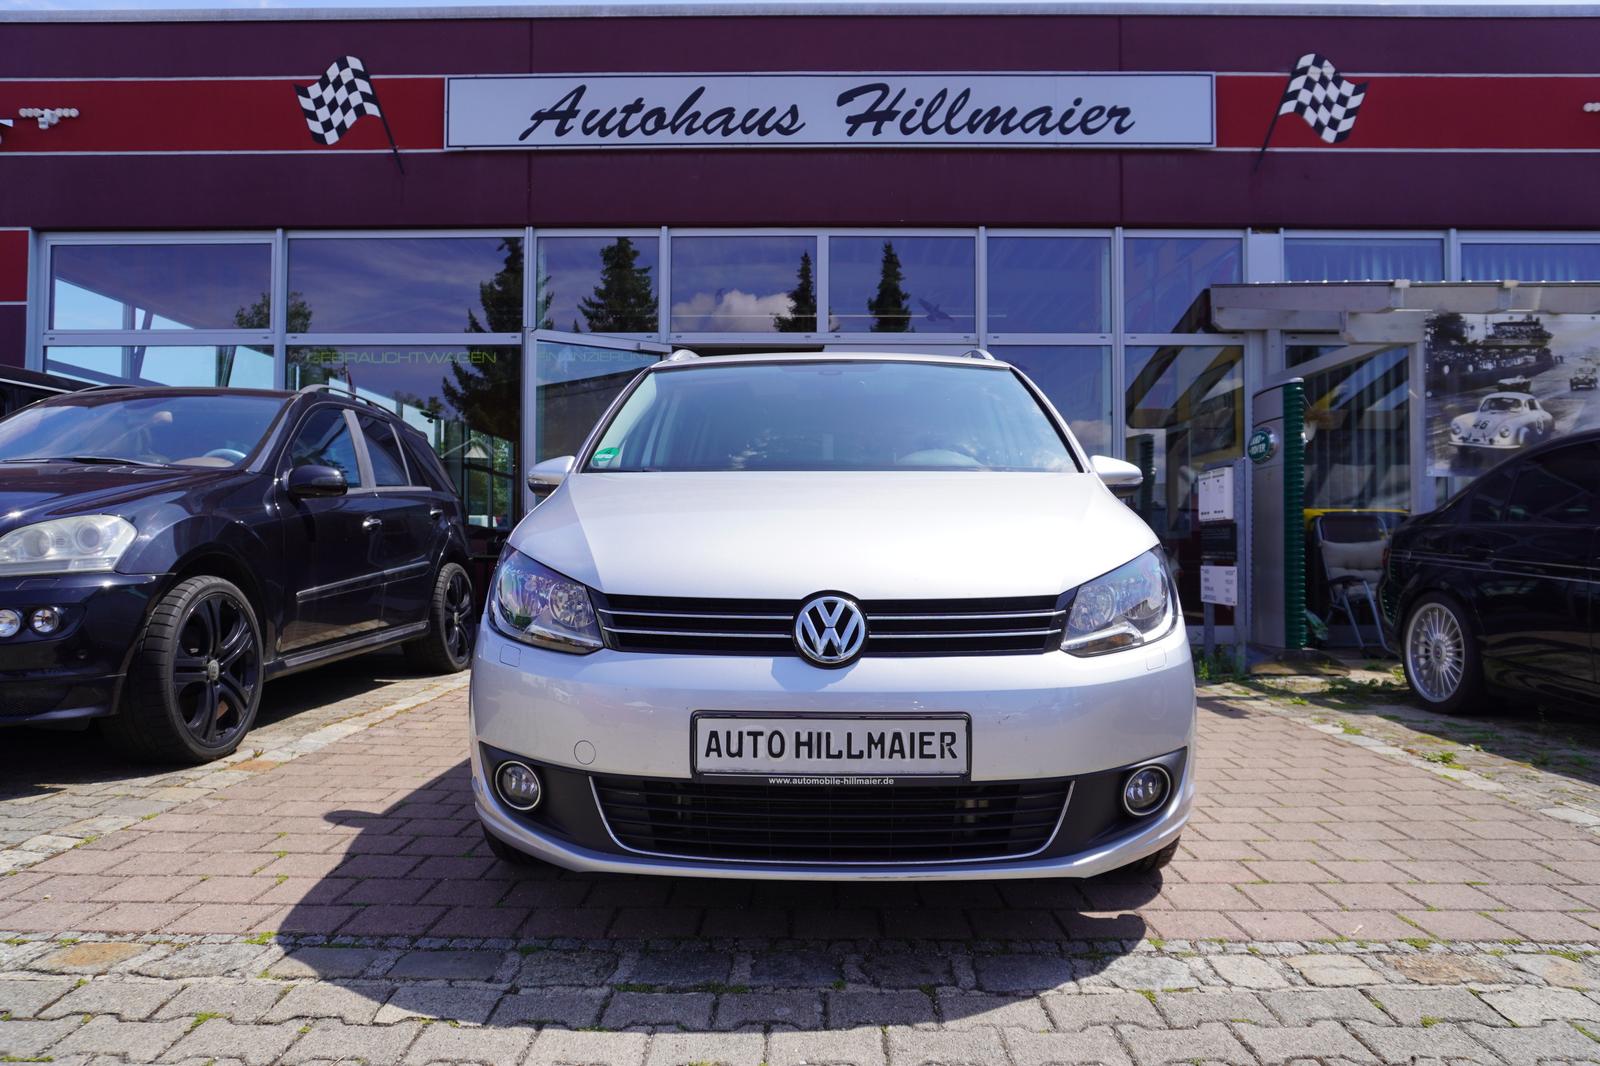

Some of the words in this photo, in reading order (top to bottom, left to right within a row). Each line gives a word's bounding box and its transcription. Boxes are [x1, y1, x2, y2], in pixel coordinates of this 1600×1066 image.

[518, 84, 806, 141] Autohaus
[836, 82, 1136, 136] Hillmaier
[306, 351, 497, 364] GEBRAUCHTWAGEN
[704, 730, 786, 759] AUTO
[794, 731, 958, 760] HILLMAIER
[768, 775, 895, 786] www.automobile-hillmaier.de
